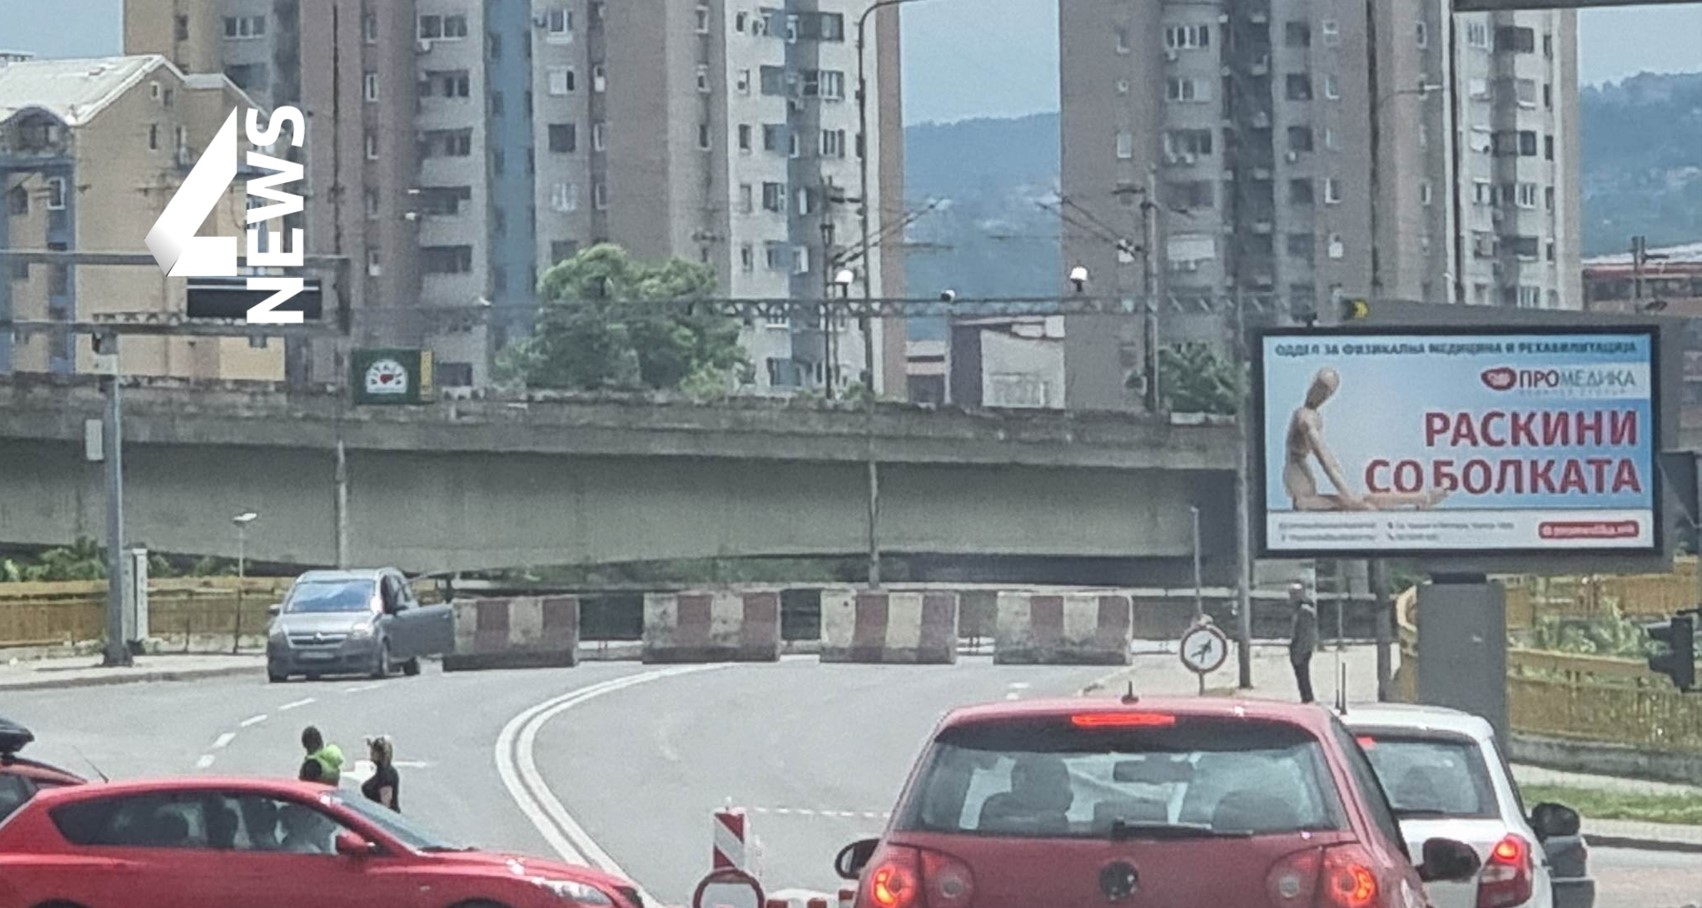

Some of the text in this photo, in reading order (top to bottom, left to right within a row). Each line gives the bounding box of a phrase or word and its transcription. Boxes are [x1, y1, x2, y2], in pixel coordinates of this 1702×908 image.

[1324, 344, 1340, 355] ЗА
[1342, 344, 1425, 355] ФИЗИКАЛНА
[1428, 343, 1502, 355] МЕДИЦИНА
[1506, 343, 1515, 353] И
[1519, 369, 1636, 388] ПРОМЕДИКА
[1425, 411, 1638, 447] РАСКИНИ
[1365, 458, 1642, 494] СО БОЛКАТА
